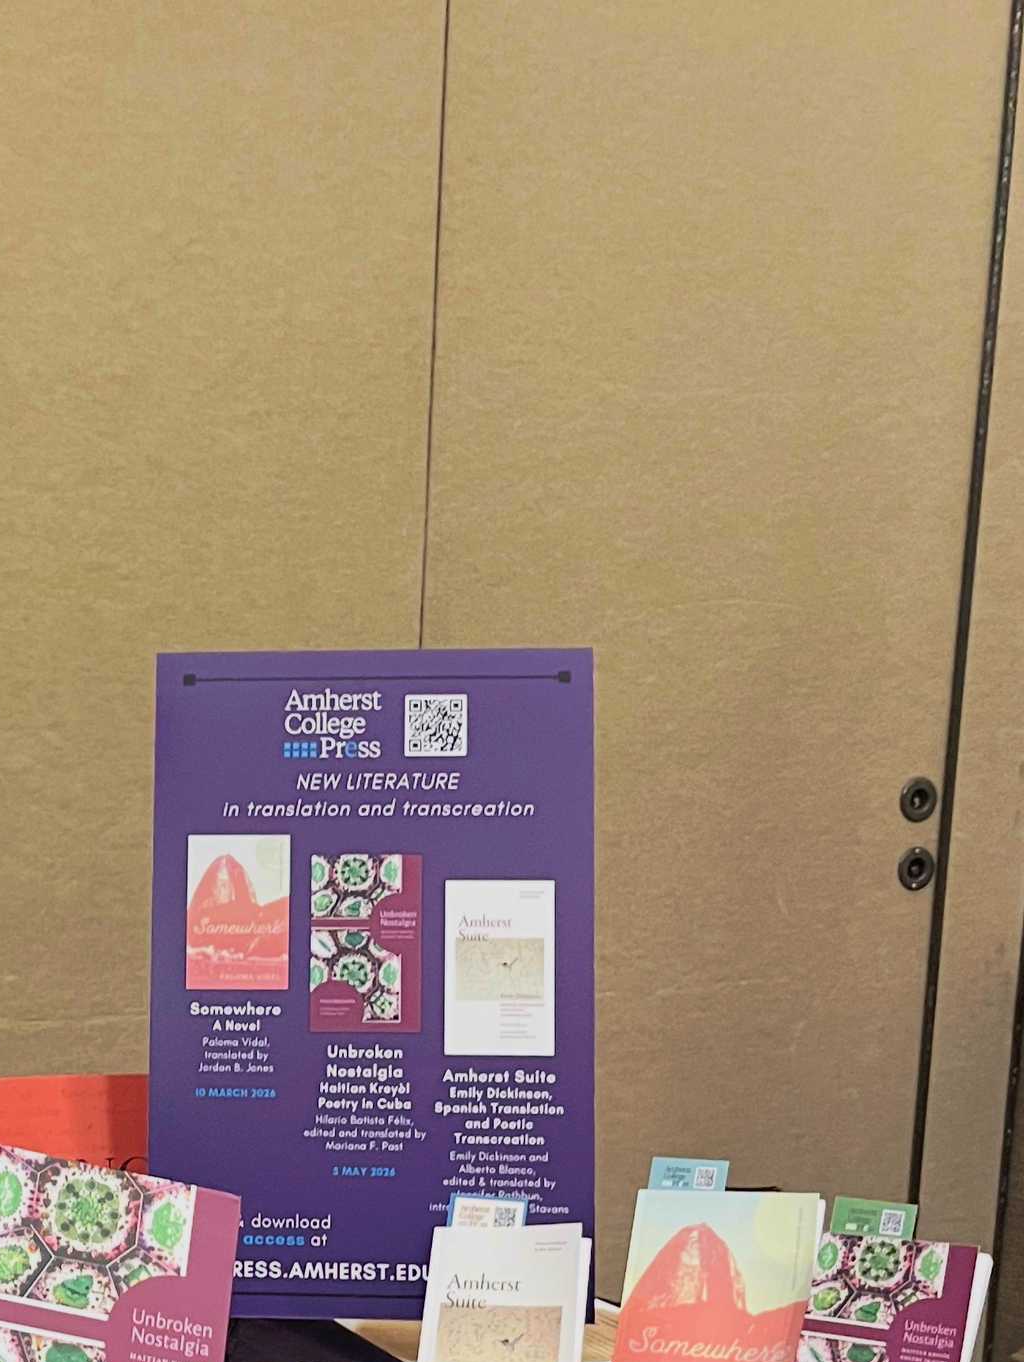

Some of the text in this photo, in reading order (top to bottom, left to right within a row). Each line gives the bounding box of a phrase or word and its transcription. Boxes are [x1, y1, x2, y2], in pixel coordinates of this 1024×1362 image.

[284, 688, 382, 711] Amherst
[284, 713, 366, 739] College
[319, 738, 381, 759] Press
[296, 772, 460, 791] NEW LITERATURE
[223, 799, 535, 817] in translation and transcreation
[190, 1001, 282, 1016] Somewhere
[212, 1020, 260, 1032] A Novel
[202, 1036, 270, 1048] Paloma Vidal,
[205, 1049, 269, 1062] translated by
[327, 1043, 403, 1059] Unbroken
[198, 1062, 231, 1072] Jordan
[246, 1062, 274, 1073] Jones
[327, 1063, 403, 1082] Nostalgia
[442, 1068, 557, 1084] Amherst Suite
[195, 1088, 276, 1098] 10 MARCH 2026
[319, 1082, 366, 1094] Haitian
[449, 1087, 553, 1101] Emily Dickinson,
[318, 1097, 411, 1112] Poetry in Cuba
[434, 1101, 564, 1116] Spanish Translation
[316, 1115, 347, 1125] Hilario
[350, 1115, 385, 1125] Batista
[465, 1117, 534, 1130] and Poetic
[304, 1127, 426, 1141] edited and translated by
[453, 1132, 545, 1145] Transcreation
[325, 1141, 366, 1151] Mariana
[382, 1141, 403, 1151] Past
[449, 1150, 549, 1163] Emily Dickinson and
[342, 1166, 366, 1176] MAY
[370, 1167, 396, 1177] 2026
[459, 1164, 496, 1174] Alberto
[443, 1177, 556, 1190] edited & translated by
[529, 1204, 569, 1214] Stavans
[251, 1213, 331, 1229] download
[243, 1233, 327, 1246] access at
[447, 1272, 521, 1292] Amherst
[446, 1291, 487, 1310] Suite
[132, 1307, 213, 1338] Unbroken
[905, 1320, 957, 1336] Unbroken
[131, 1325, 209, 1357] Nostalgia
[903, 1331, 954, 1349] Nostalgia
